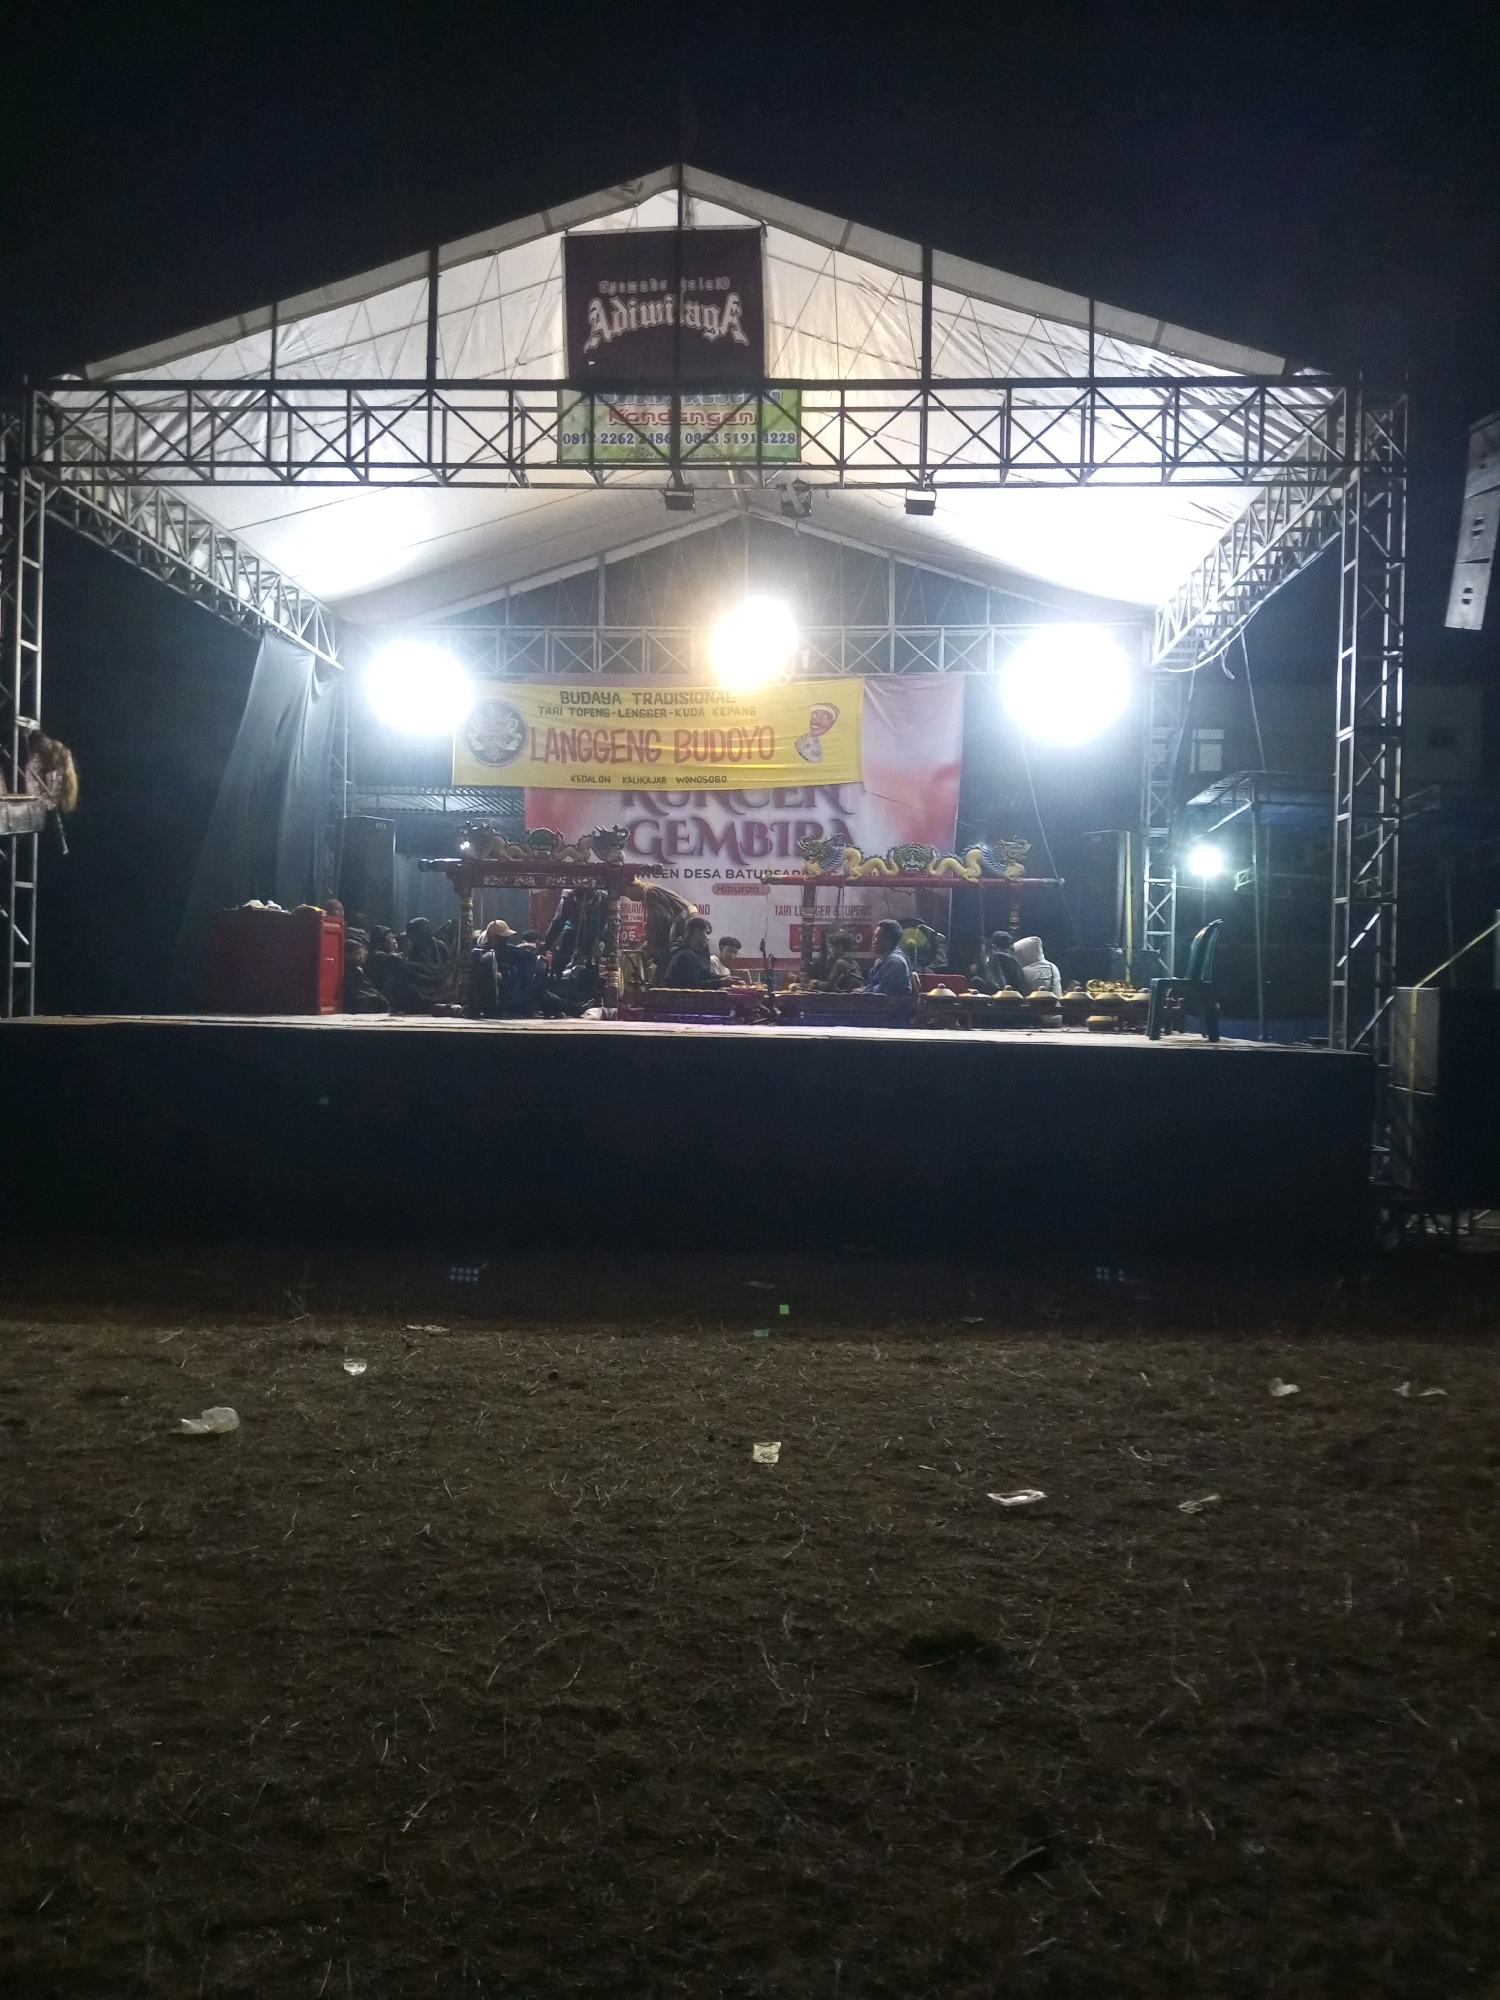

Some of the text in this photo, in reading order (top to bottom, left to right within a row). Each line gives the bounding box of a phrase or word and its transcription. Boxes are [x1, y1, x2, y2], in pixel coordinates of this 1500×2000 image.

[563, 432, 596, 445] 081
[600, 432, 635, 445] 2262
[559, 691, 736, 705] BUDAYA TRADISIONAL
[538, 706, 563, 716] TARI
[712, 706, 757, 717] KEPANG
[530, 725, 775, 764] LANGGENG BUDOYO
[570, 775, 728, 784] KEDALON KALIKAJAR WONOSOBO
[684, 869, 722, 879] DESA
[774, 905, 792, 916] TARI
